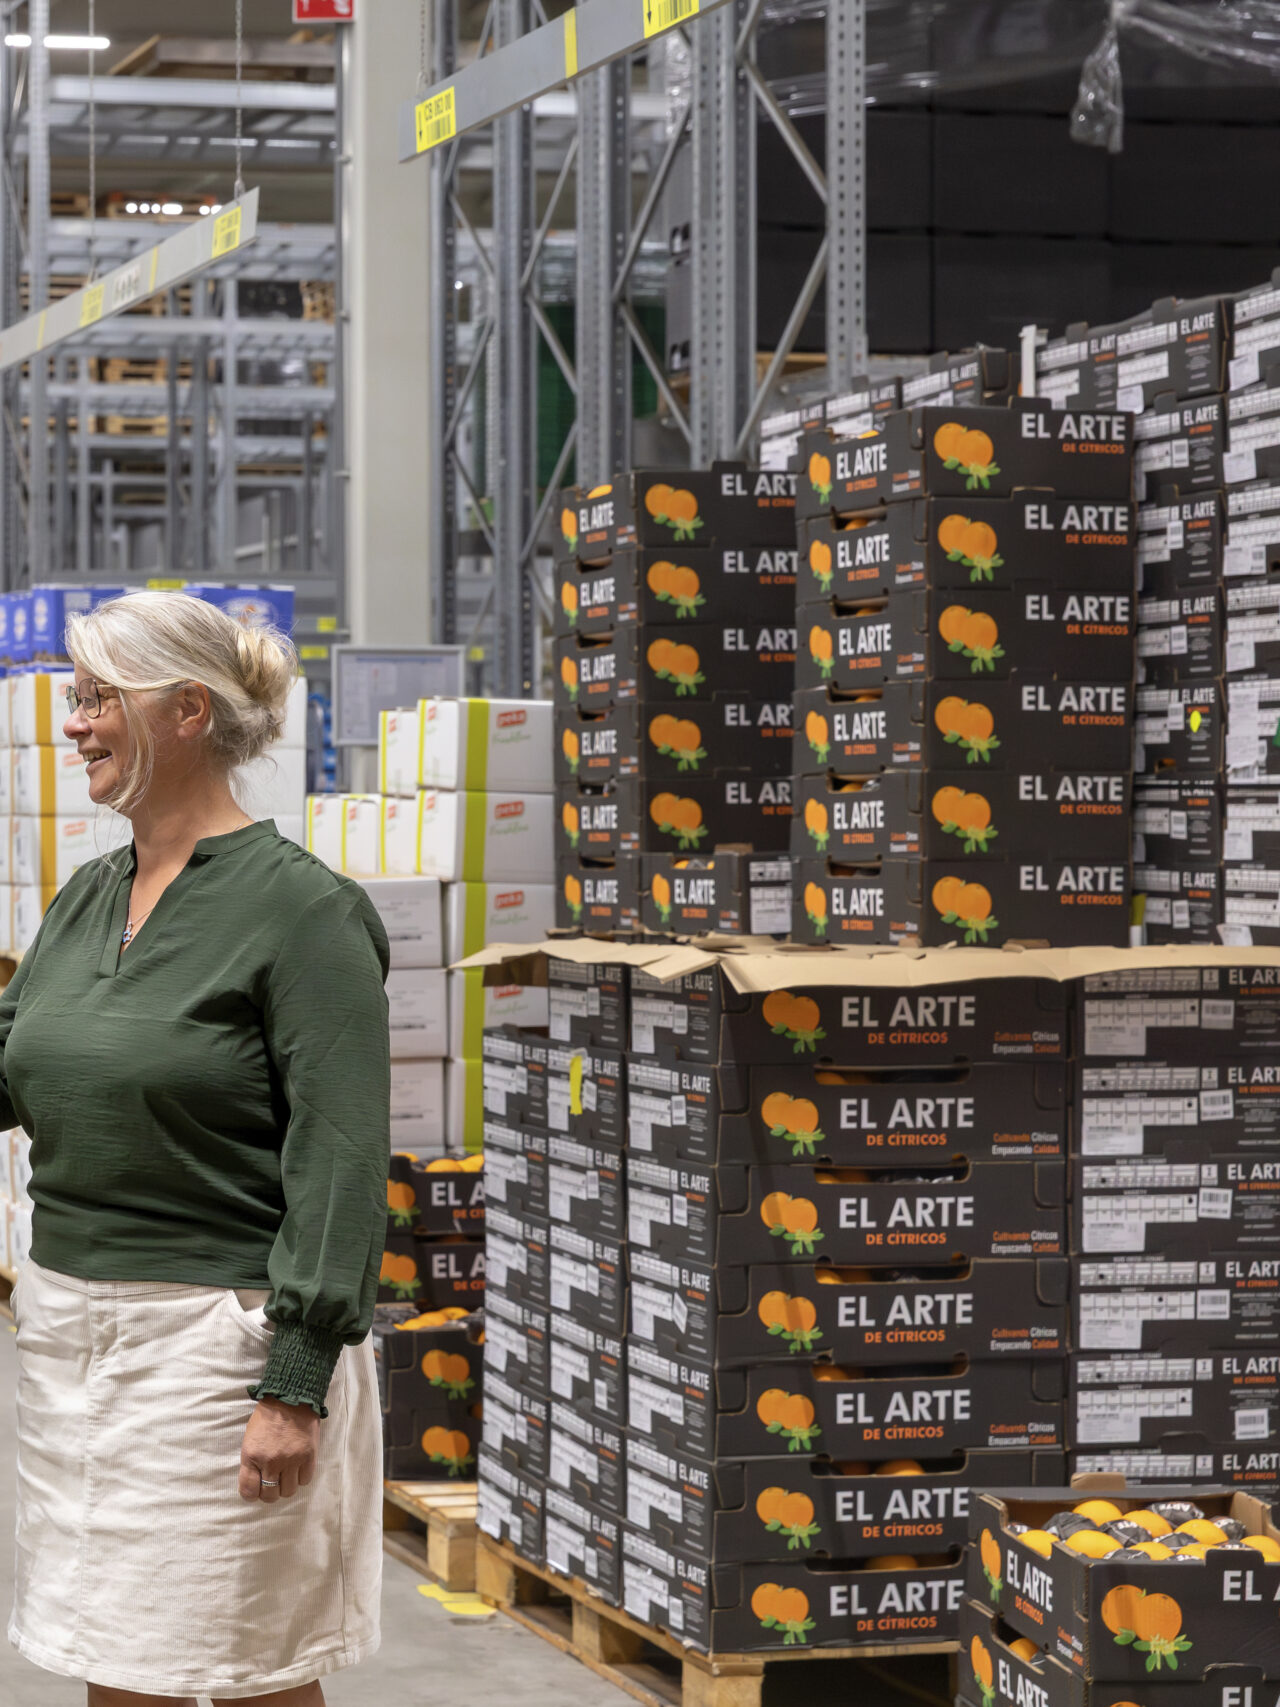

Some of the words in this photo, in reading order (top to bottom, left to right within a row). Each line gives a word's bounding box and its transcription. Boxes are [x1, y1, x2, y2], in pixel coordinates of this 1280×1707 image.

[1022, 413, 1050, 438] EL
[1059, 415, 1125, 440] ARTE
[1063, 443, 1076, 452] DE
[837, 452, 851, 479] EL
[854, 443, 887, 476] ARTE
[722, 474, 747, 495] EL
[754, 474, 798, 495] ART
[1025, 505, 1053, 529] EL
[1062, 506, 1128, 531] ARTE
[1066, 534, 1079, 544] DE
[724, 551, 749, 572] EL
[756, 551, 799, 572] ART
[838, 541, 852, 568] EL
[855, 534, 889, 565] ARTE
[1026, 595, 1054, 620] EL
[1063, 596, 1129, 621] ARTE
[724, 629, 749, 650] EL
[756, 629, 798, 650] ART
[839, 629, 854, 655] EL
[857, 624, 891, 654] ARTE
[1067, 624, 1080, 634] DE
[1022, 686, 1050, 711] EL
[1059, 687, 1125, 712] ARTE
[725, 704, 751, 725] EL
[758, 704, 795, 725] AR
[1063, 715, 1076, 724] DE
[834, 714, 849, 741] EL
[852, 711, 886, 739] ARTE
[1020, 776, 1048, 800] EL
[1056, 776, 1122, 801] ARTE
[1060, 805, 1073, 814] DE
[1020, 866, 1049, 890] EL
[1057, 867, 1123, 891] ARTE
[832, 888, 847, 915] EL
[850, 888, 883, 916] ARTE
[1061, 895, 1074, 904] DE
[1229, 969, 1246, 984] EL
[1252, 968, 1280, 984] ART
[842, 997, 878, 1027] EL
[889, 996, 975, 1026] ARTE
[868, 1033, 884, 1044] DE
[889, 1032, 948, 1044] CÍTRICOS
[1228, 1068, 1246, 1083] EL
[1251, 1067, 1280, 1083] ART
[840, 1099, 877, 1129] EL
[888, 1098, 973, 1128] ARTE
[867, 1135, 883, 1145] DE
[888, 1134, 946, 1146] CÍTRICOS
[1228, 1164, 1245, 1180] EL
[1251, 1163, 1280, 1179] ART
[840, 1198, 876, 1228] EL
[887, 1197, 973, 1227] ARTE
[866, 1234, 882, 1244] DE
[887, 1233, 946, 1244] CÍTRICOS
[1226, 1262, 1243, 1277] EL
[1249, 1261, 1280, 1277] ART
[838, 1296, 875, 1327] EL
[886, 1294, 972, 1325] ARTE
[865, 1332, 881, 1343] DE
[886, 1328, 945, 1343] CÍTRICOS
[1223, 1358, 1241, 1374] EL
[1246, 1357, 1280, 1373] ART
[837, 1393, 873, 1424] EL
[884, 1389, 970, 1422] ARTE
[864, 1429, 880, 1440] DE
[885, 1425, 944, 1439] CÍTRICOS
[836, 1491, 873, 1521] EL
[884, 1487, 970, 1520] ARTE
[863, 1526, 879, 1537] DE
[884, 1523, 942, 1537] CÍTRICOS
[1007, 1550, 1020, 1589] EL
[1023, 1563, 1052, 1612] ARTE
[1223, 1571, 1262, 1601] EL
[830, 1585, 867, 1616] EL
[878, 1580, 964, 1613] ARTE
[857, 1620, 873, 1631] DE
[878, 1616, 936, 1630] CÍTRICOS
[999, 1659, 1014, 1699] EL
